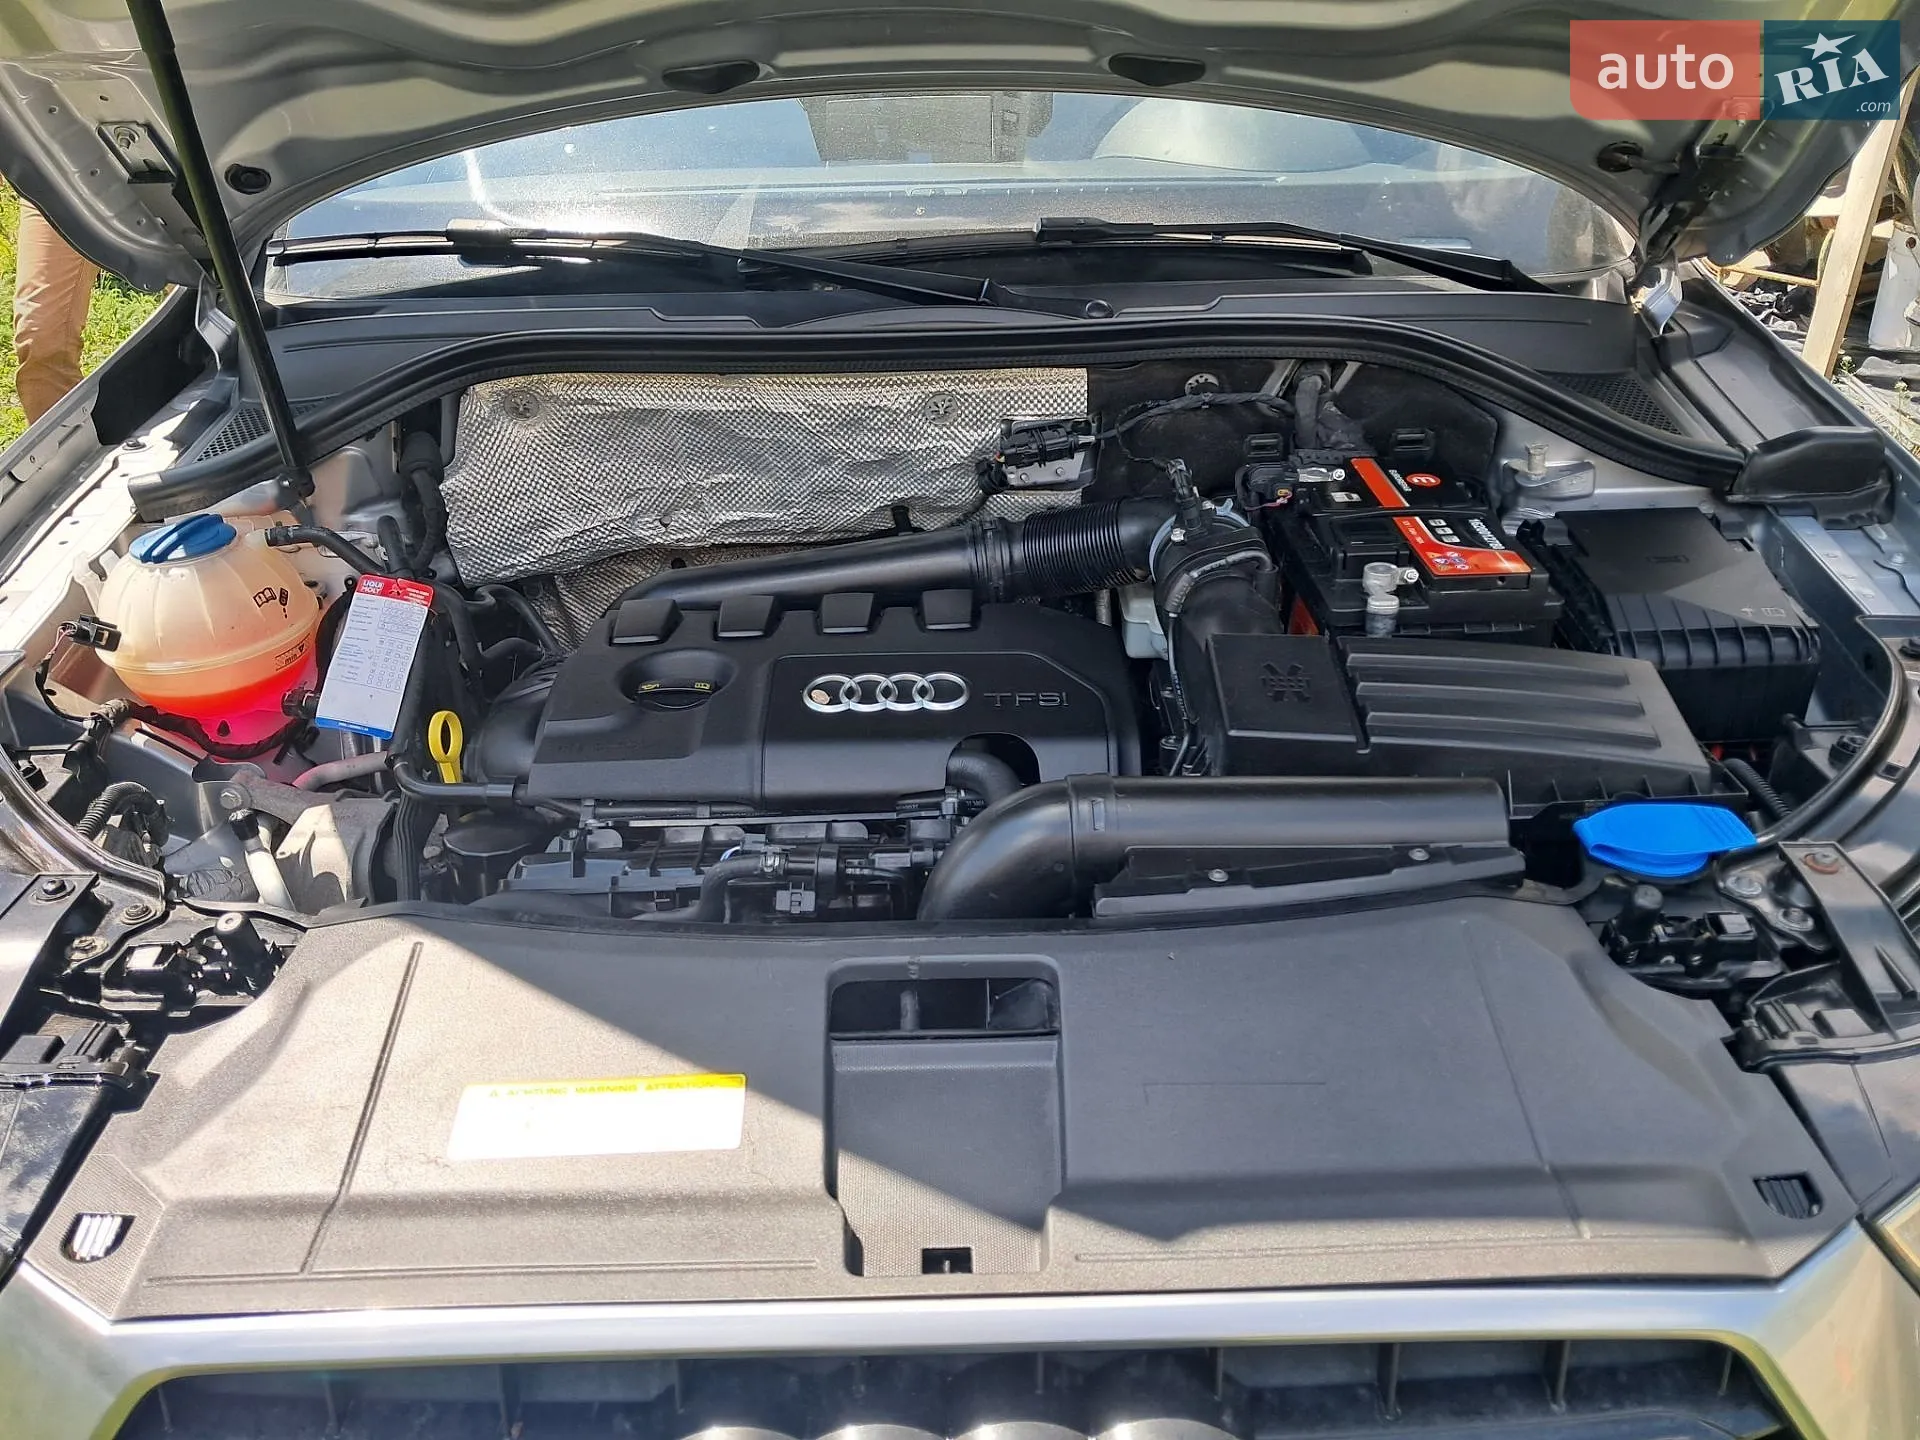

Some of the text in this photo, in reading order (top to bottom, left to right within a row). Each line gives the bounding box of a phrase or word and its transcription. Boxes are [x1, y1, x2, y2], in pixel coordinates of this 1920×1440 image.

[361, 586, 381, 594] MOLY
[363, 580, 384, 589] LIQUI
[983, 691, 1069, 708] TFSI
[507, 1081, 719, 1096] ACHTUNG WARNING ATTENTION
